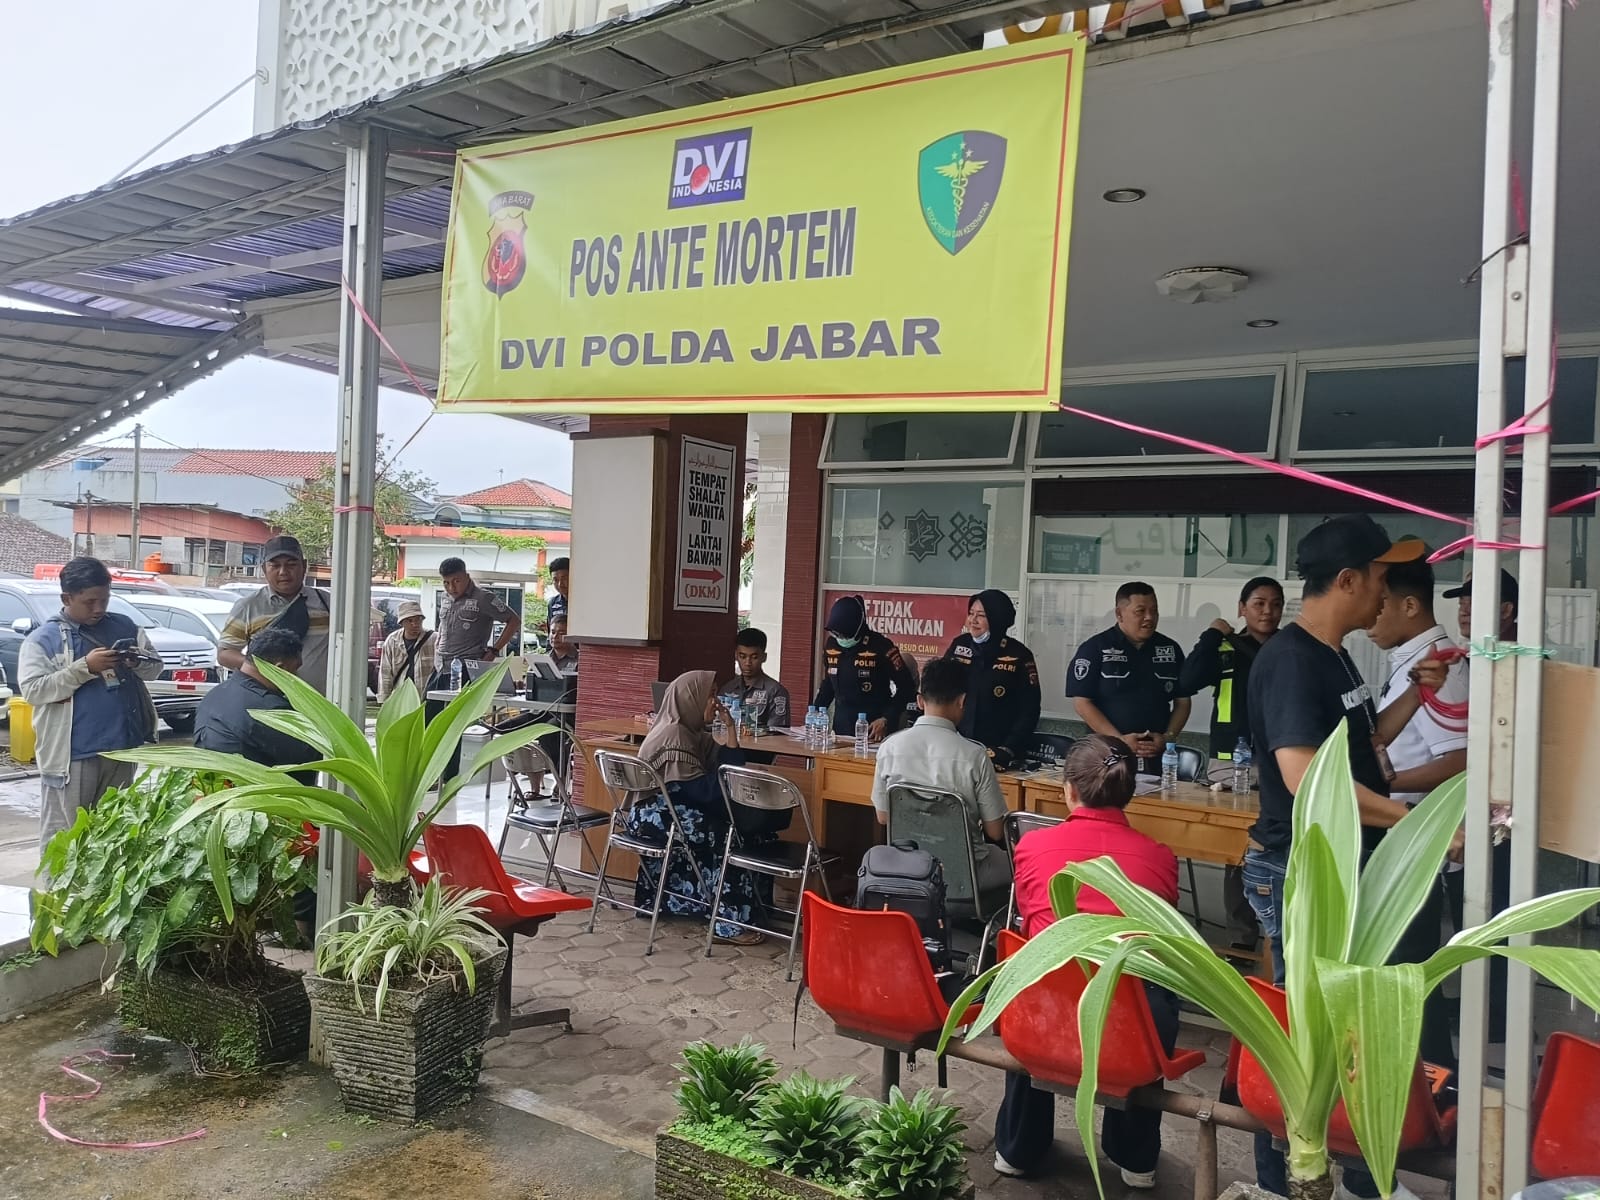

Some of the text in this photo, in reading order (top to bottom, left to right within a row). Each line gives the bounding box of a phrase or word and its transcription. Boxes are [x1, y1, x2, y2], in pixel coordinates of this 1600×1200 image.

[673, 139, 748, 186] DVI
[569, 206, 857, 298] POS ANTE MORTEM
[500, 317, 942, 370] DVI POLDA JABAR
[689, 469, 727, 491] TEMPAT
[688, 486, 726, 506] SHALAT
[688, 501, 725, 521] WANITA
[701, 519, 712, 535] DI
[688, 533, 722, 551] LANTAI
[687, 549, 722, 566] BAWAH
[684, 583, 721, 601] (DKM)
[873, 600, 914, 618] TIDAK
[918, 643, 939, 654] CIAWI
[854, 659, 876, 668] POLRI
